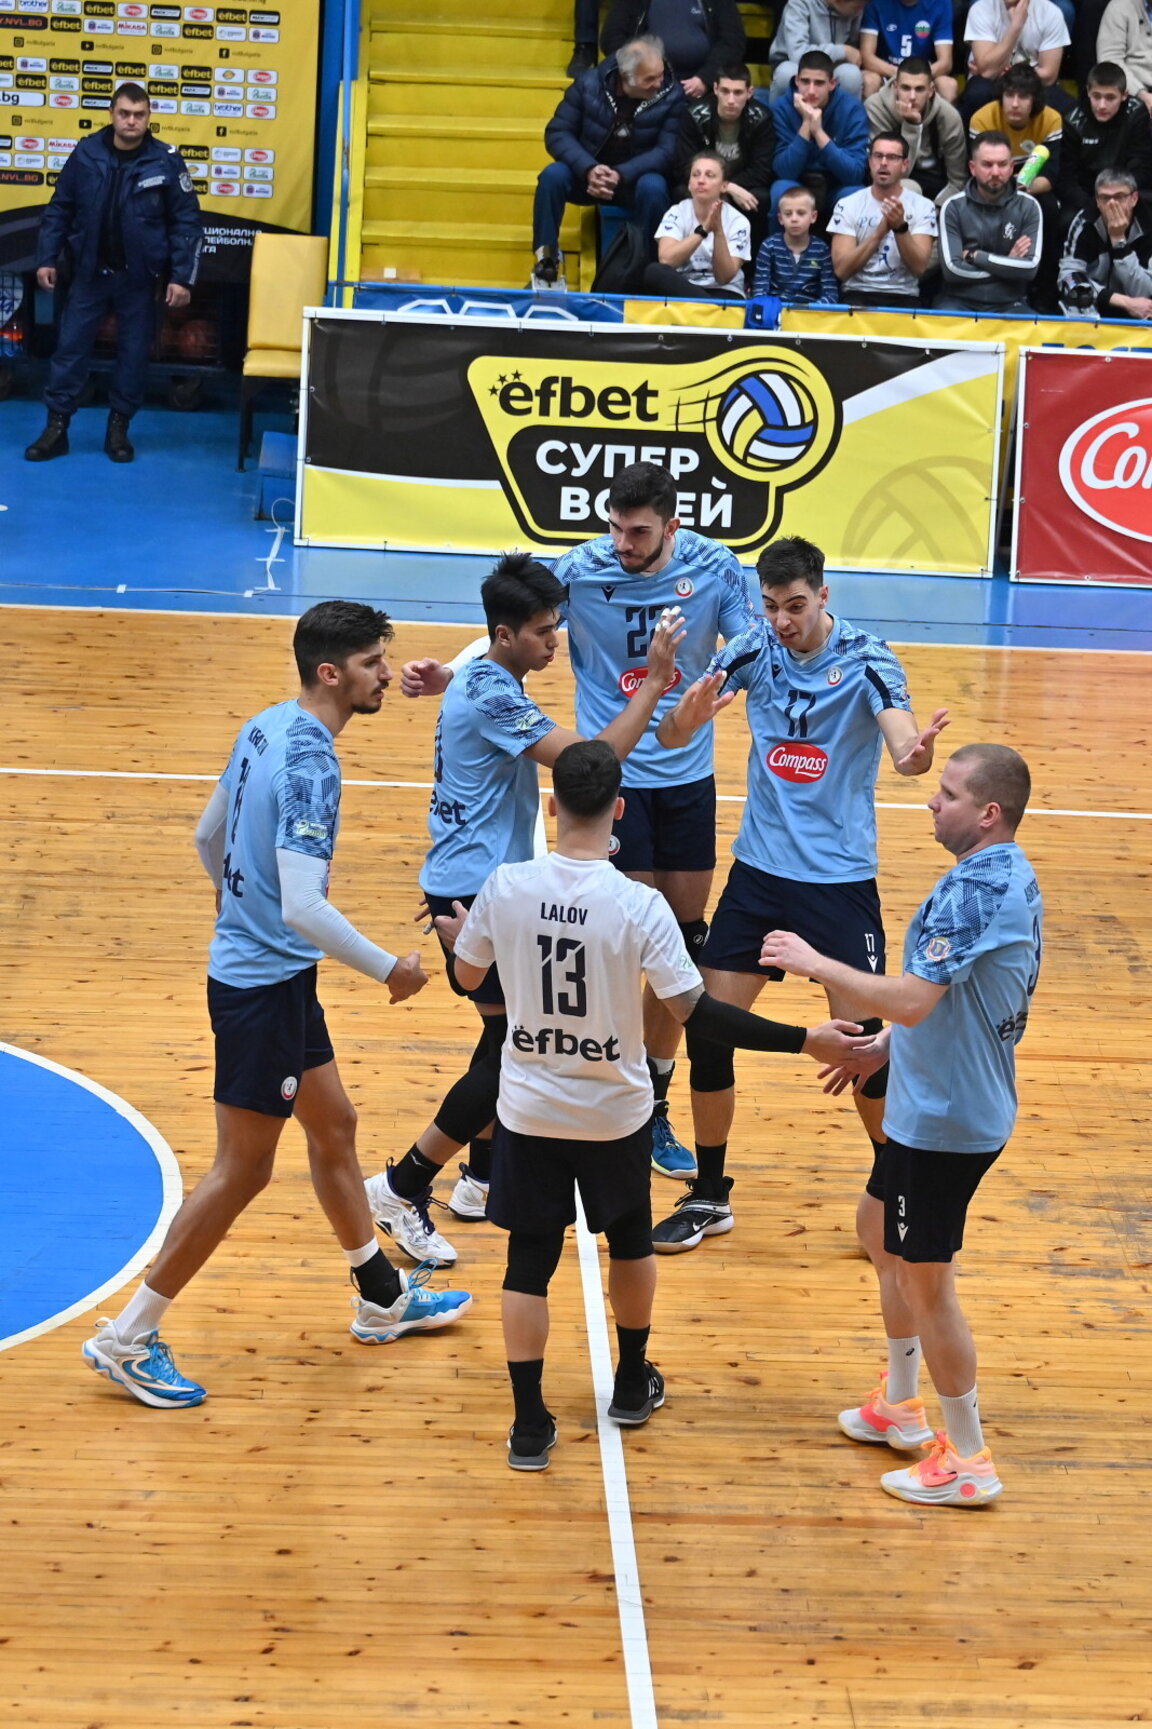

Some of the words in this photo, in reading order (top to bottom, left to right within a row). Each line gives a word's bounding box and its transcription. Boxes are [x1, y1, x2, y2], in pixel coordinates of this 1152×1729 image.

[900, 34, 912, 57] 5
[214, 102, 242, 112] brother
[559, 475, 733, 528] ВЕЙ
[784, 689, 817, 738] 17
[769, 746, 828, 778] Compass
[540, 902, 588, 926] LALOV
[864, 933, 875, 953] 17
[537, 934, 587, 1018] 13
[897, 1194, 906, 1217] 3
